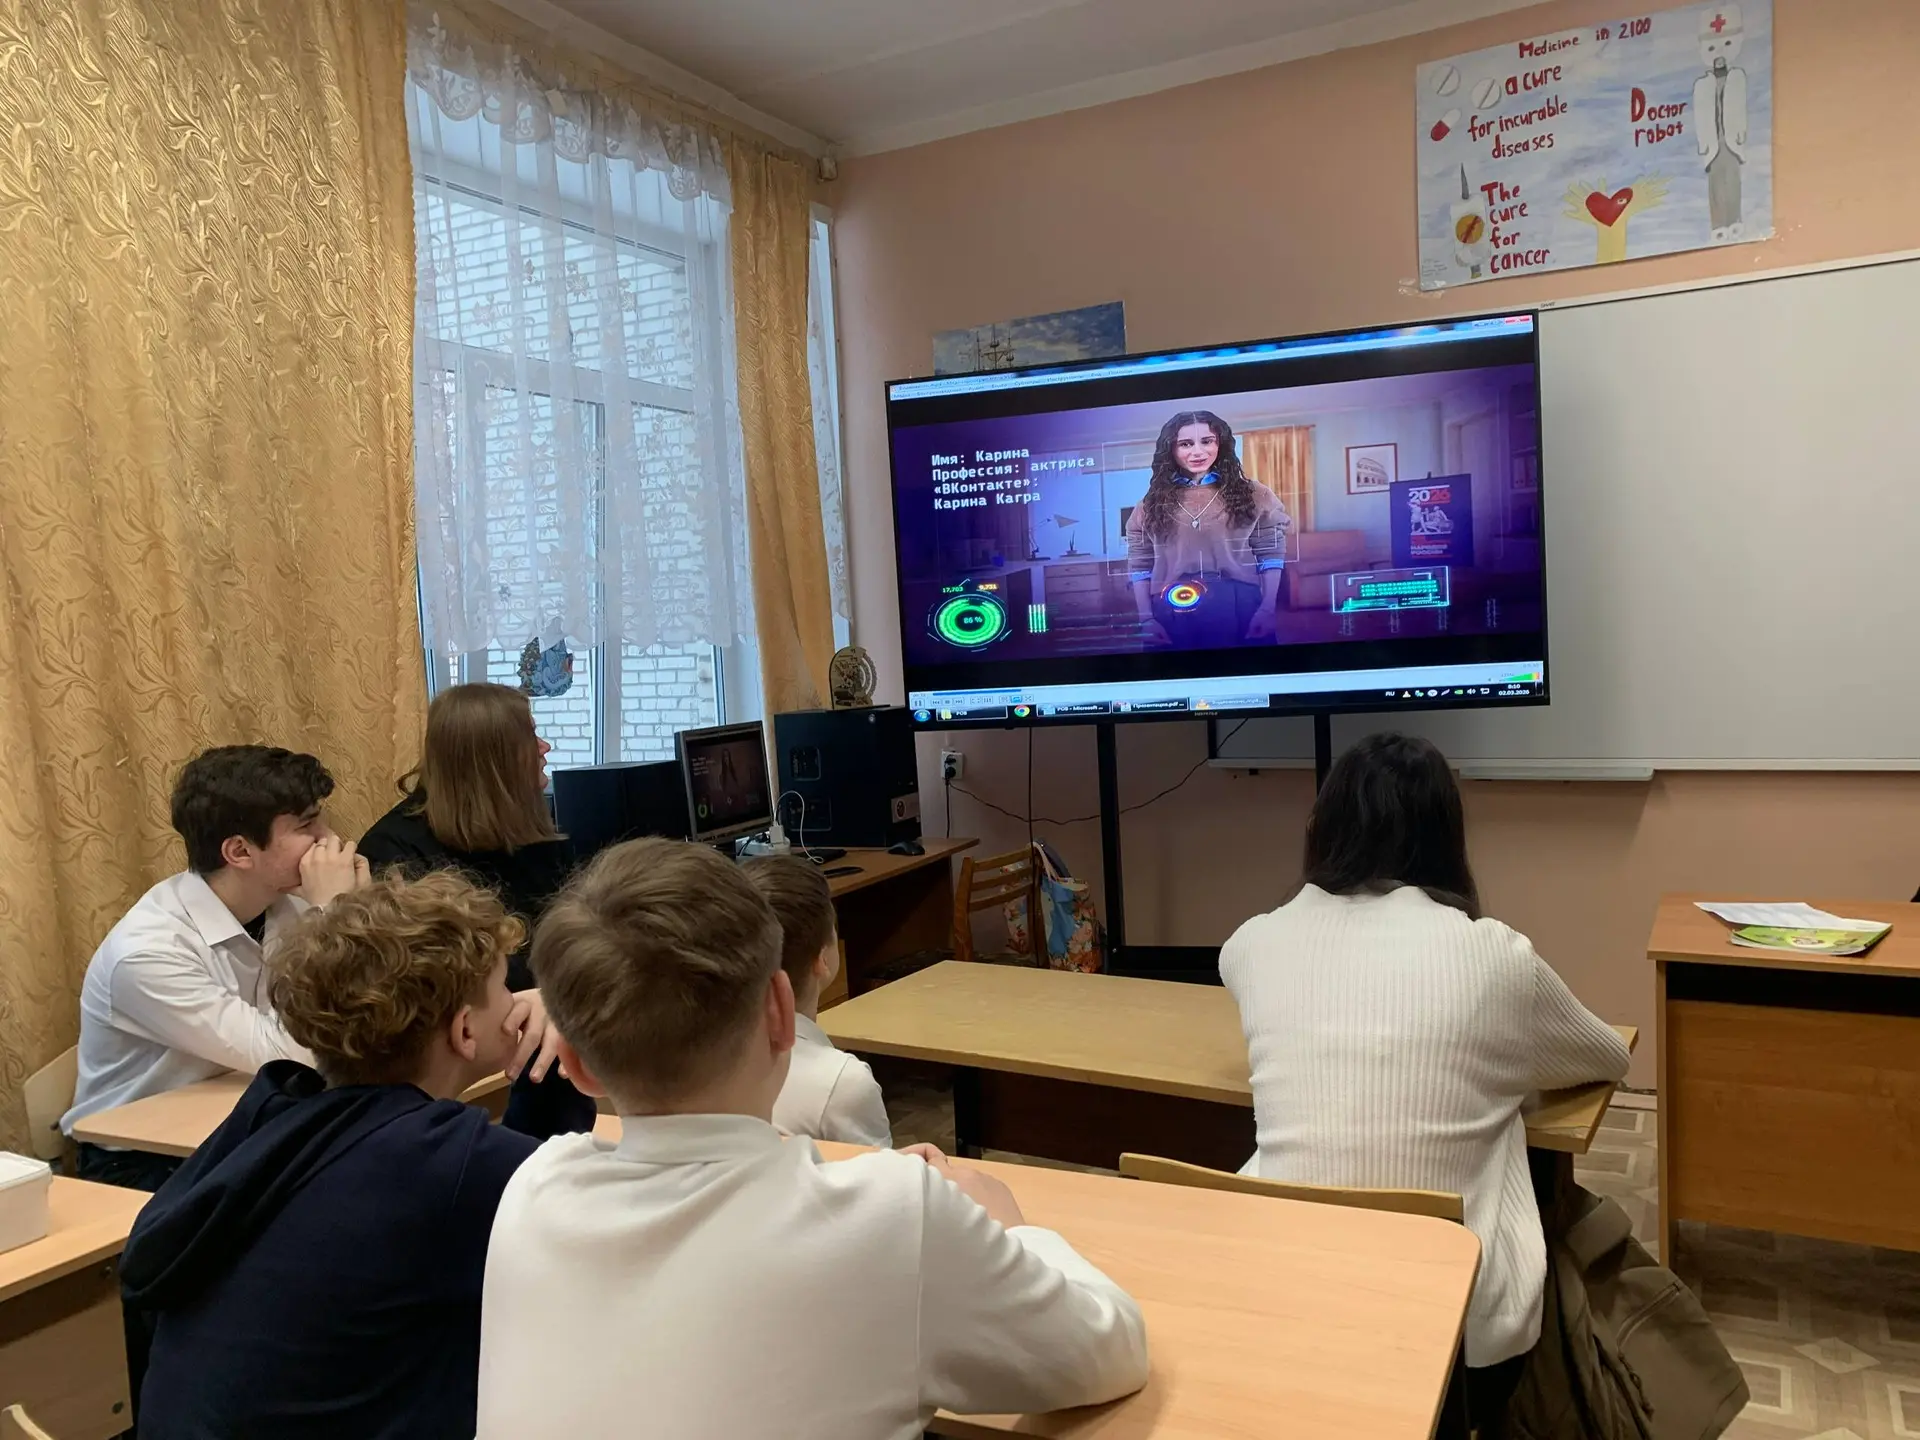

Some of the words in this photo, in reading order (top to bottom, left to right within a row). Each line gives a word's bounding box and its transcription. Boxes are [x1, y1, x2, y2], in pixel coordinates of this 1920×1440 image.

[1519, 37, 1579, 58] Medicine
[1595, 28, 1610, 41] in
[1618, 17, 1652, 39] 2100
[1505, 76, 1518, 95] a
[1523, 65, 1562, 91] cure
[1631, 87, 1688, 123] Doctor
[1467, 116, 1496, 142] for
[1499, 95, 1568, 132] incurable
[1491, 132, 1554, 159] diseases
[1635, 123, 1684, 148] robot
[1480, 181, 1521, 207] The
[1489, 203, 1529, 225] cure
[1489, 227, 1520, 249] for
[1490, 247, 1551, 275] cancer
[931, 453, 965, 467] Имя:
[975, 448, 1030, 463] Карина
[932, 463, 1019, 482] Профессия:
[1030, 456, 1095, 473] актриса
[934, 476, 1039, 495] «ВКонтакте»:
[1408, 488, 1451, 502] 2026
[934, 497, 987, 511] Карина
[996, 492, 1041, 506] Кагра
